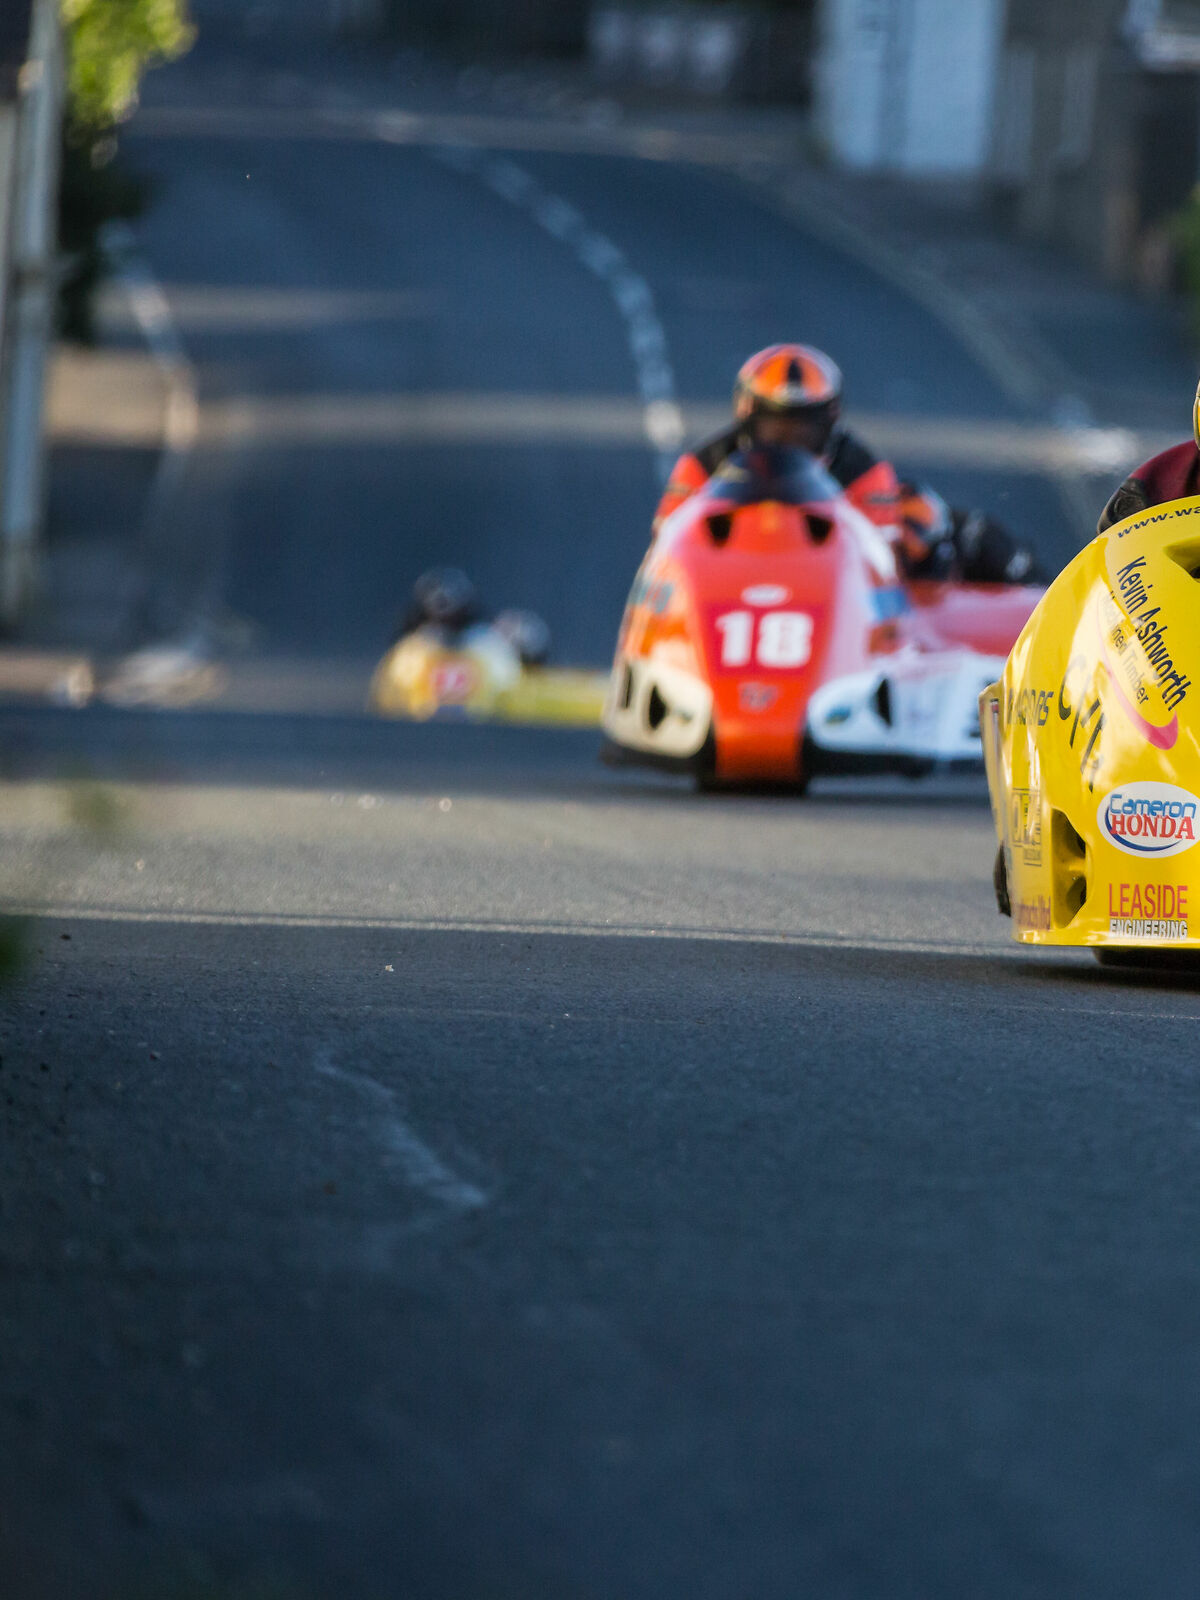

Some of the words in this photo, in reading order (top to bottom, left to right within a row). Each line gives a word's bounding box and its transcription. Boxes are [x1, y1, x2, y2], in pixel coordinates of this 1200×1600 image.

[1116, 555, 1153, 614] Kevin
[715, 611, 814, 667] 18
[1134, 607, 1191, 711] Ashworth
[1109, 794, 1197, 819] Cameron
[1109, 812, 1196, 840] HONDA
[1109, 884, 1188, 918] LEASIDE
[1110, 919, 1188, 940] ENGINEERING
